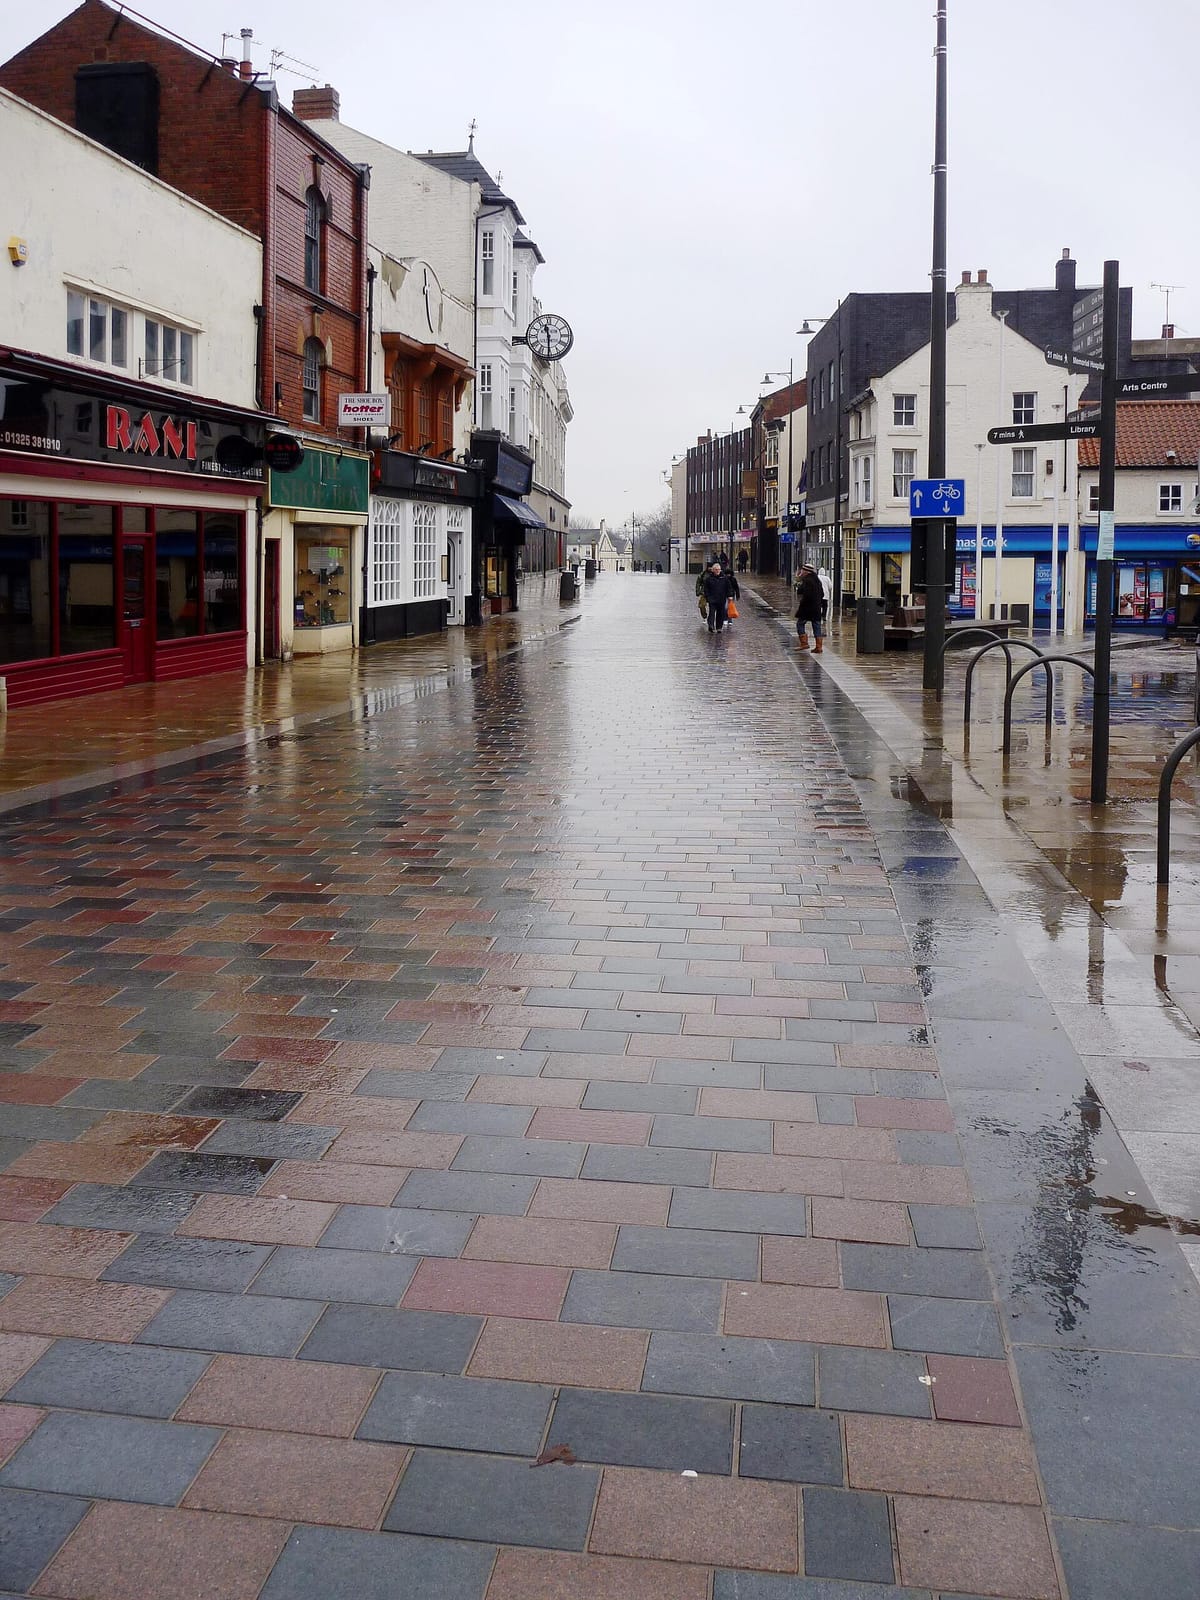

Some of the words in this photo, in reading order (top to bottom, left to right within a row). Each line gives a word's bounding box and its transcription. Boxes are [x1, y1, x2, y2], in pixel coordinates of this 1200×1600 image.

[1053, 352, 1063, 361] mins
[1122, 384, 1139, 392] Arts
[1141, 382, 1168, 390] Centre
[343, 404, 384, 412] hotter
[107, 404, 197, 460] RANI
[1070, 425, 1096, 434] Library
[5, 431, 30, 446] 01325
[32, 436, 61, 451] 381910
[202, 461, 221, 472] FINEST
[981, 536, 1008, 547] Cok
